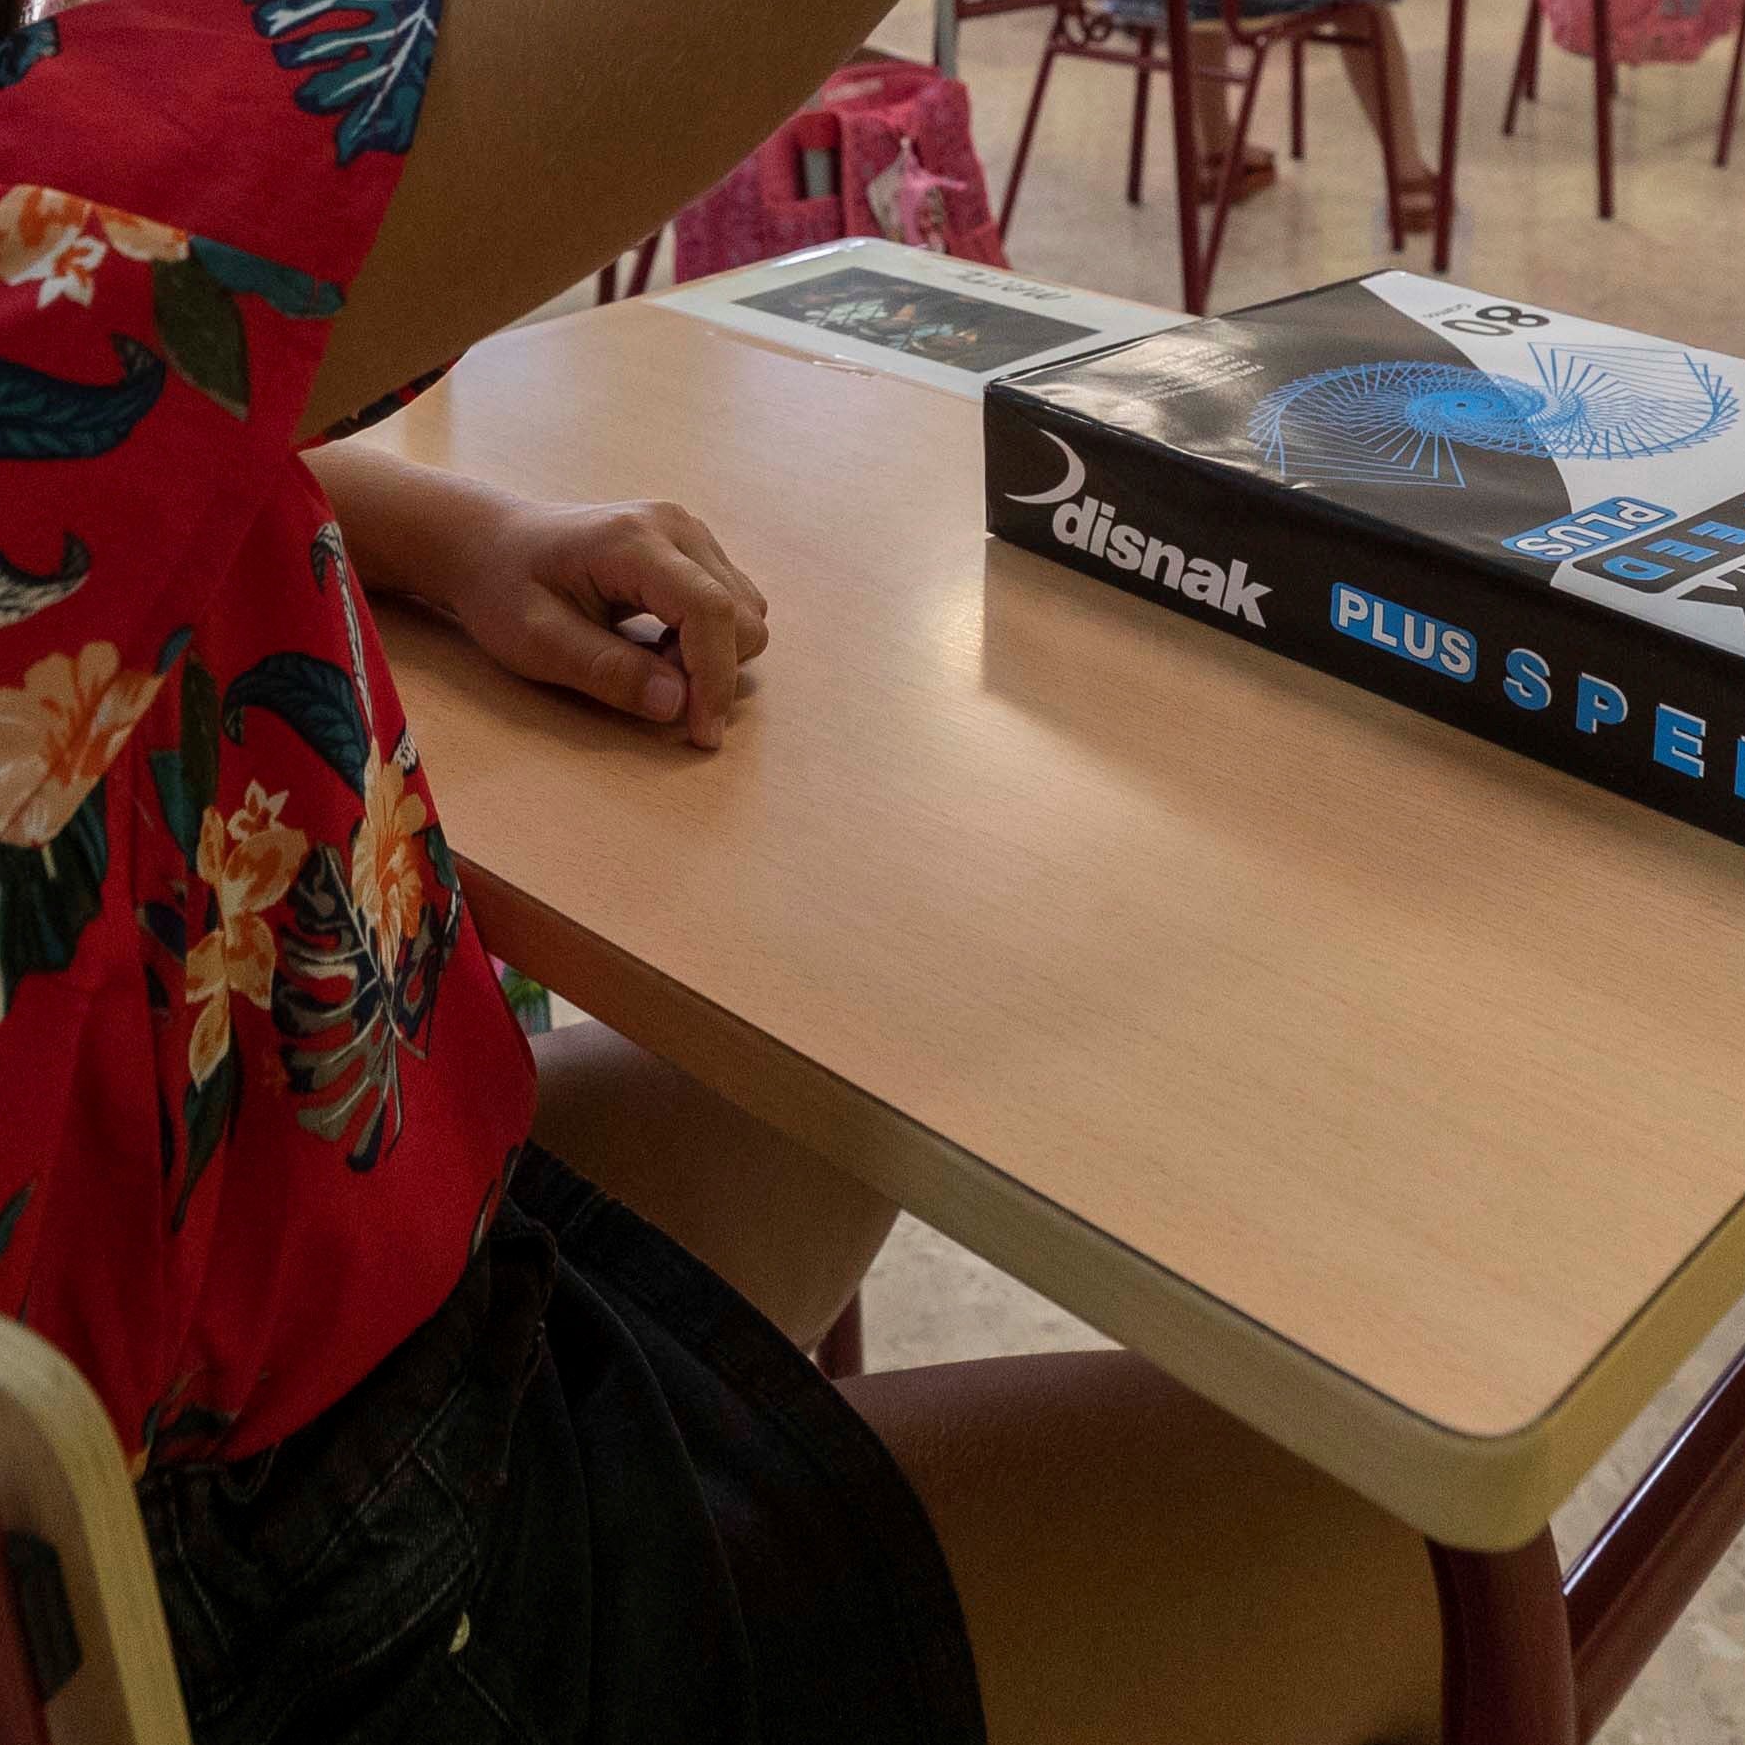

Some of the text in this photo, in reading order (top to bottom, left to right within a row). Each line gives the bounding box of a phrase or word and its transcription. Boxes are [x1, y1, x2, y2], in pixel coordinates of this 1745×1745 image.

[1440, 305, 1551, 337] 80
[1514, 500, 1668, 558] PLUS
[1051, 498, 1275, 629] disnak
[1337, 586, 1473, 675] PLUS
